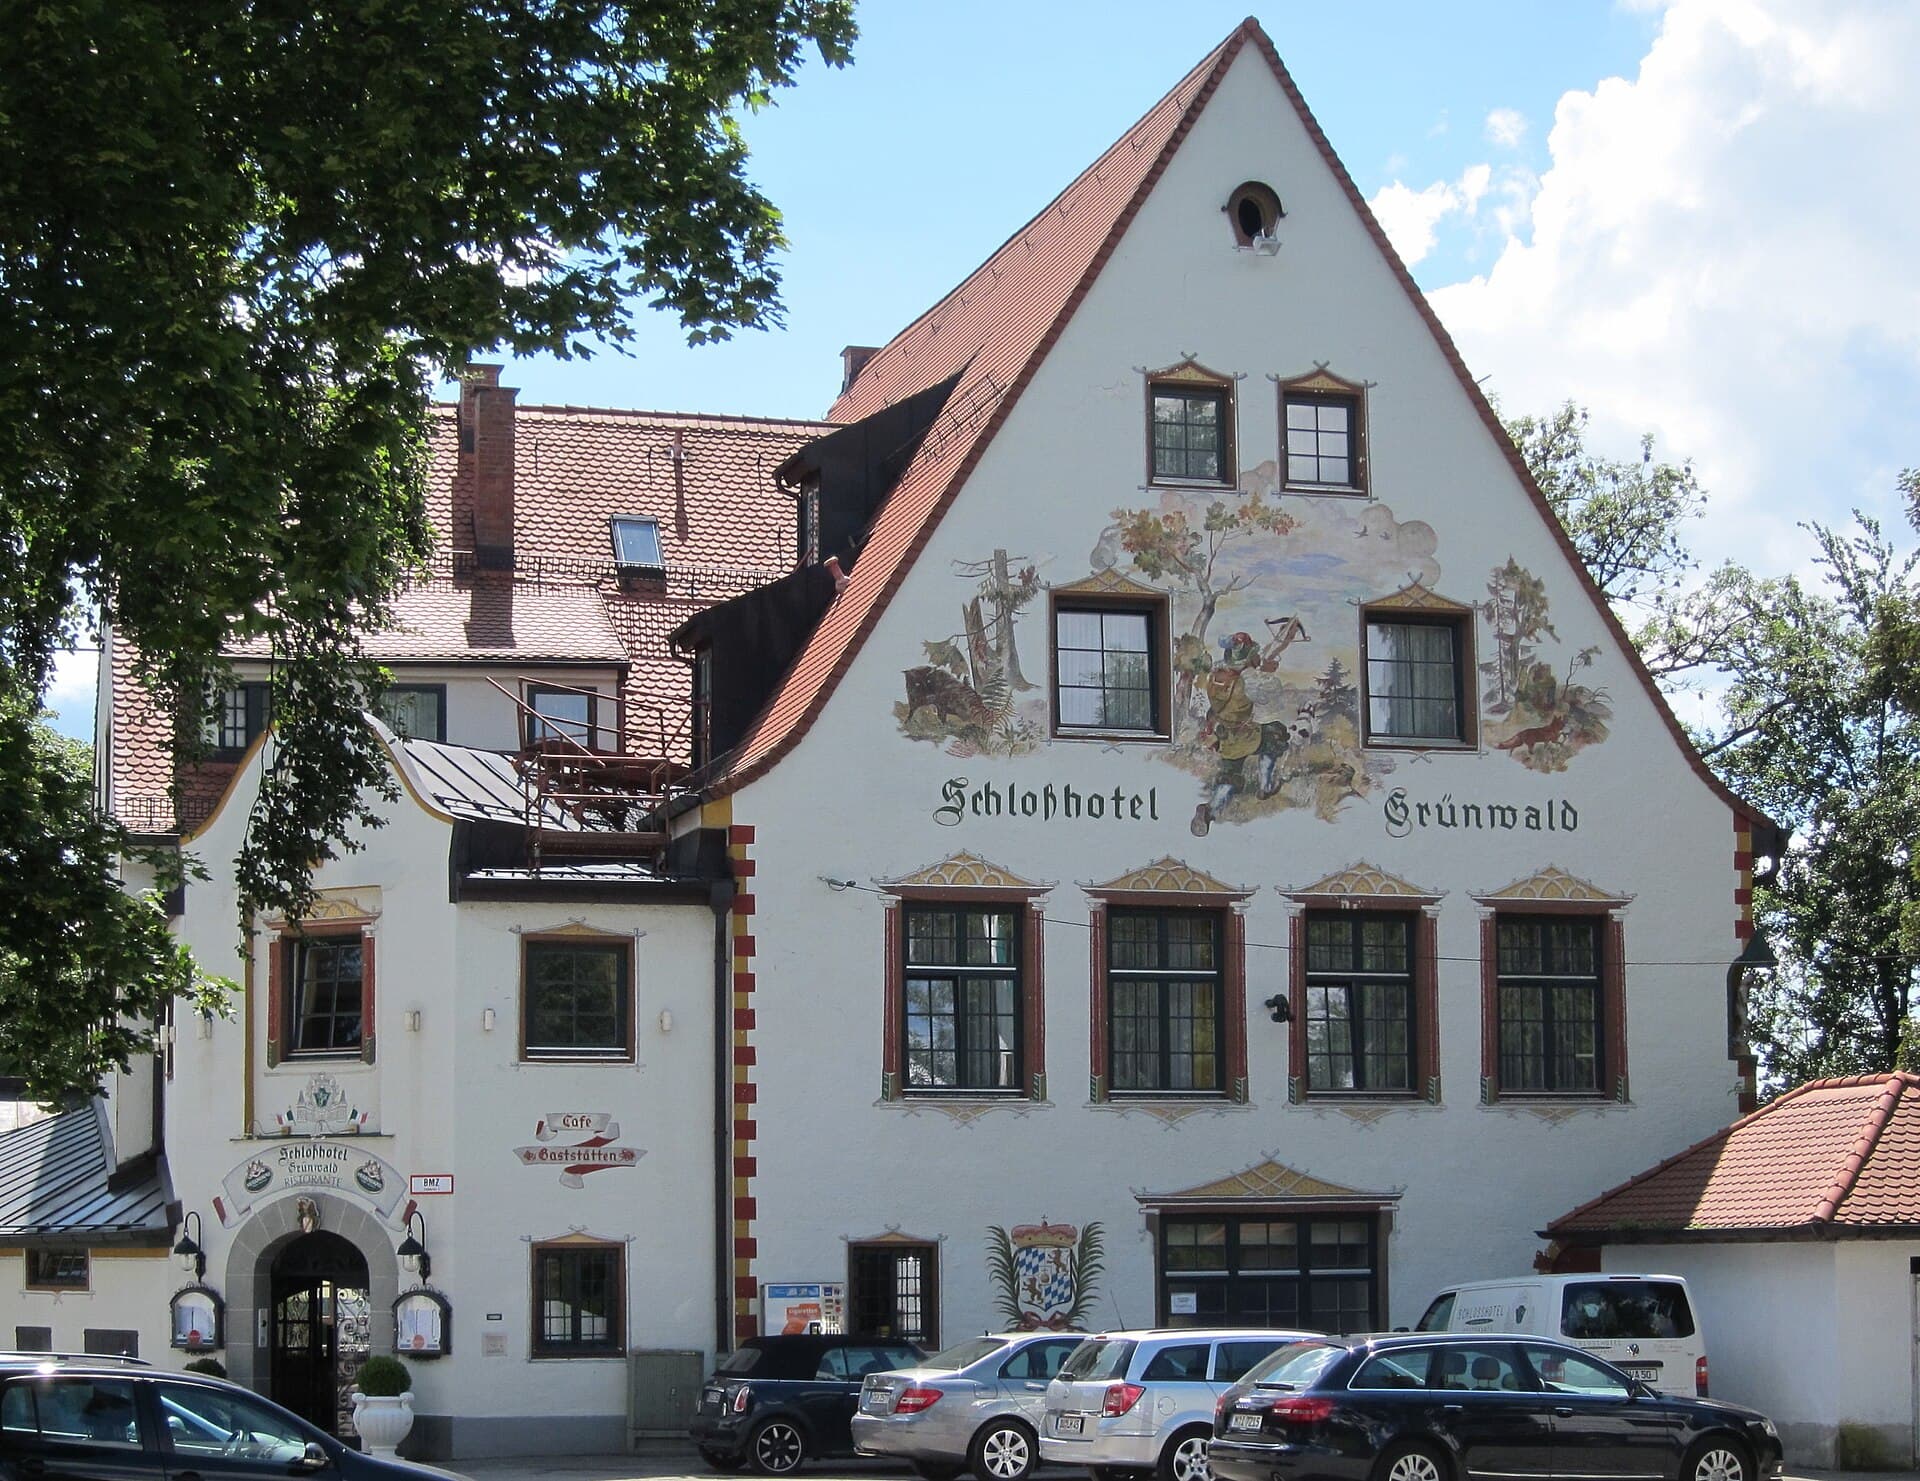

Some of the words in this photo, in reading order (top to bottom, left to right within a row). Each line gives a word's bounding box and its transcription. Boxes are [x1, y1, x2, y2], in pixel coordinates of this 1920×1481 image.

[933, 776, 1159, 827] Schloßhotel
[1384, 787, 1578, 838] Grünwald
[278, 1145, 348, 1166] Schloßhotel
[284, 1174, 343, 1188] RISTORANTE
[423, 1178, 440, 1187] BMZ
